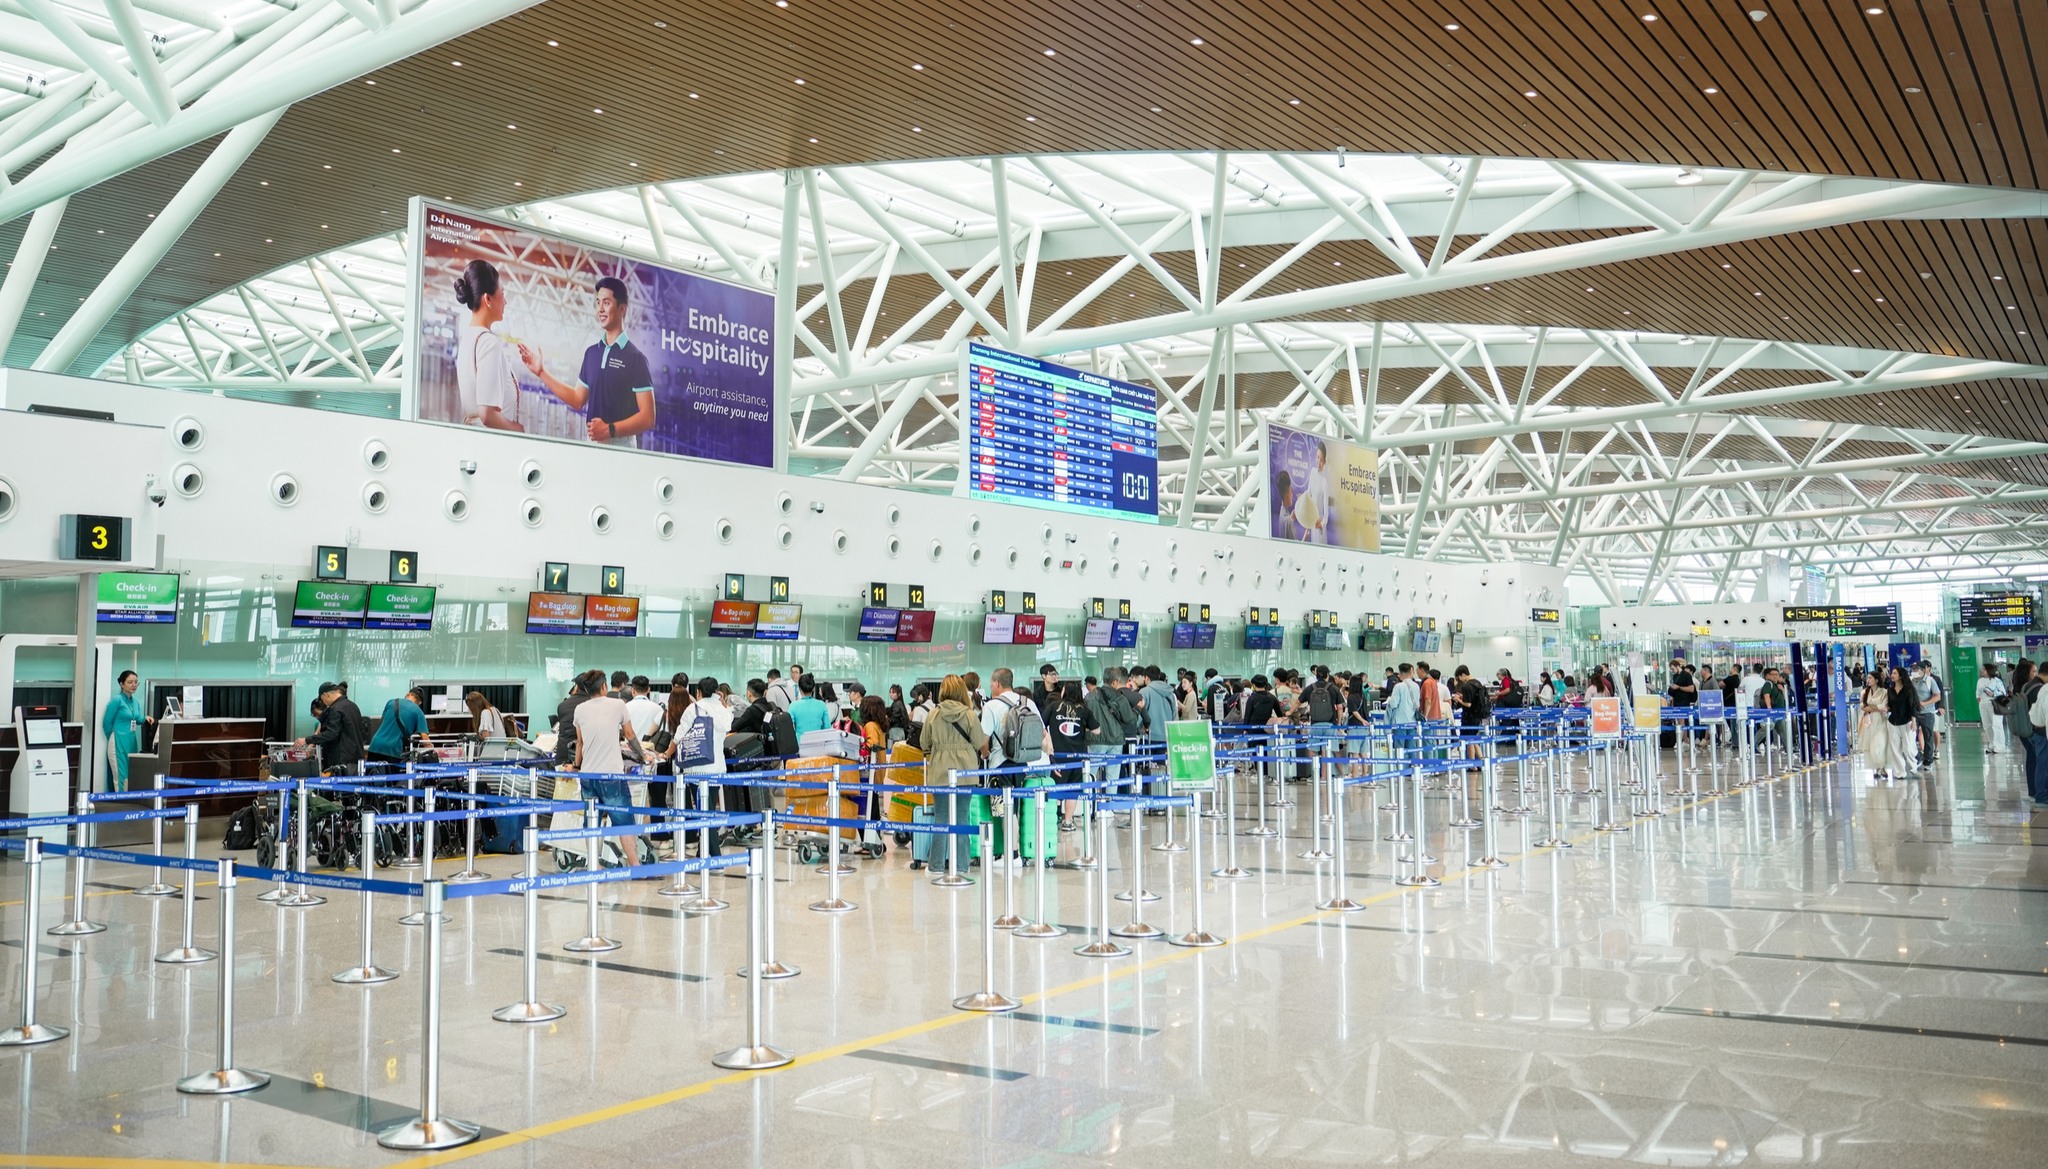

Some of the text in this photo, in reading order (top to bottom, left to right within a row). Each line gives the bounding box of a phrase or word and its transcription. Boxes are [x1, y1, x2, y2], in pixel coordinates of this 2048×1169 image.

[431, 214, 471, 231] Da Nang
[430, 225, 480, 241] International
[430, 234, 460, 245] Airport
[689, 307, 769, 345] Embrace
[686, 382, 768, 408] Airport assistance,
[693, 401, 769, 422] anytime you need
[1349, 464, 1376, 481] Embrace
[1123, 472, 1149, 500] 10:01
[92, 526, 108, 549] 3
[327, 553, 339, 571] 5
[398, 558, 409, 575] 6
[552, 569, 561, 585] 7
[609, 572, 617, 588] 8
[116, 582, 157, 592] Check-in
[731, 579, 739, 594] 9
[773, 582, 786, 596] 10
[315, 591, 349, 601] Check-in
[386, 594, 418, 603] Check-in
[874, 587, 884, 601] 11
[911, 590, 922, 603] 12
[549, 602, 577, 611] Bag drop
[993, 595, 1004, 608] 13
[1024, 597, 1034, 609] 14
[1093, 602, 1103, 614] 15
[604, 605, 631, 614] Bag drop
[768, 606, 792, 617] Priority
[1121, 603, 1129, 615] 16
[1180, 607, 1187, 617] 17
[1812, 610, 1828, 618] Dep
[873, 612, 897, 620] Diamond
[1018, 622, 1042, 640] t'way
[1172, 744, 1208, 752] Check-in
[21, 818, 55, 826] International
[685, 820, 710, 828] International
[892, 823, 903, 831] Nang
[904, 823, 931, 831] International
[552, 830, 581, 838] International
[582, 829, 602, 837] Terminal
[683, 857, 734, 871] AHT Da Nang
[272, 873, 285, 882] AHT
[301, 875, 313, 885] Nang
[313, 876, 342, 887] International
[342, 879, 362, 888] Terminal
[508, 869, 631, 892] AHT Da Nang International Terminal
